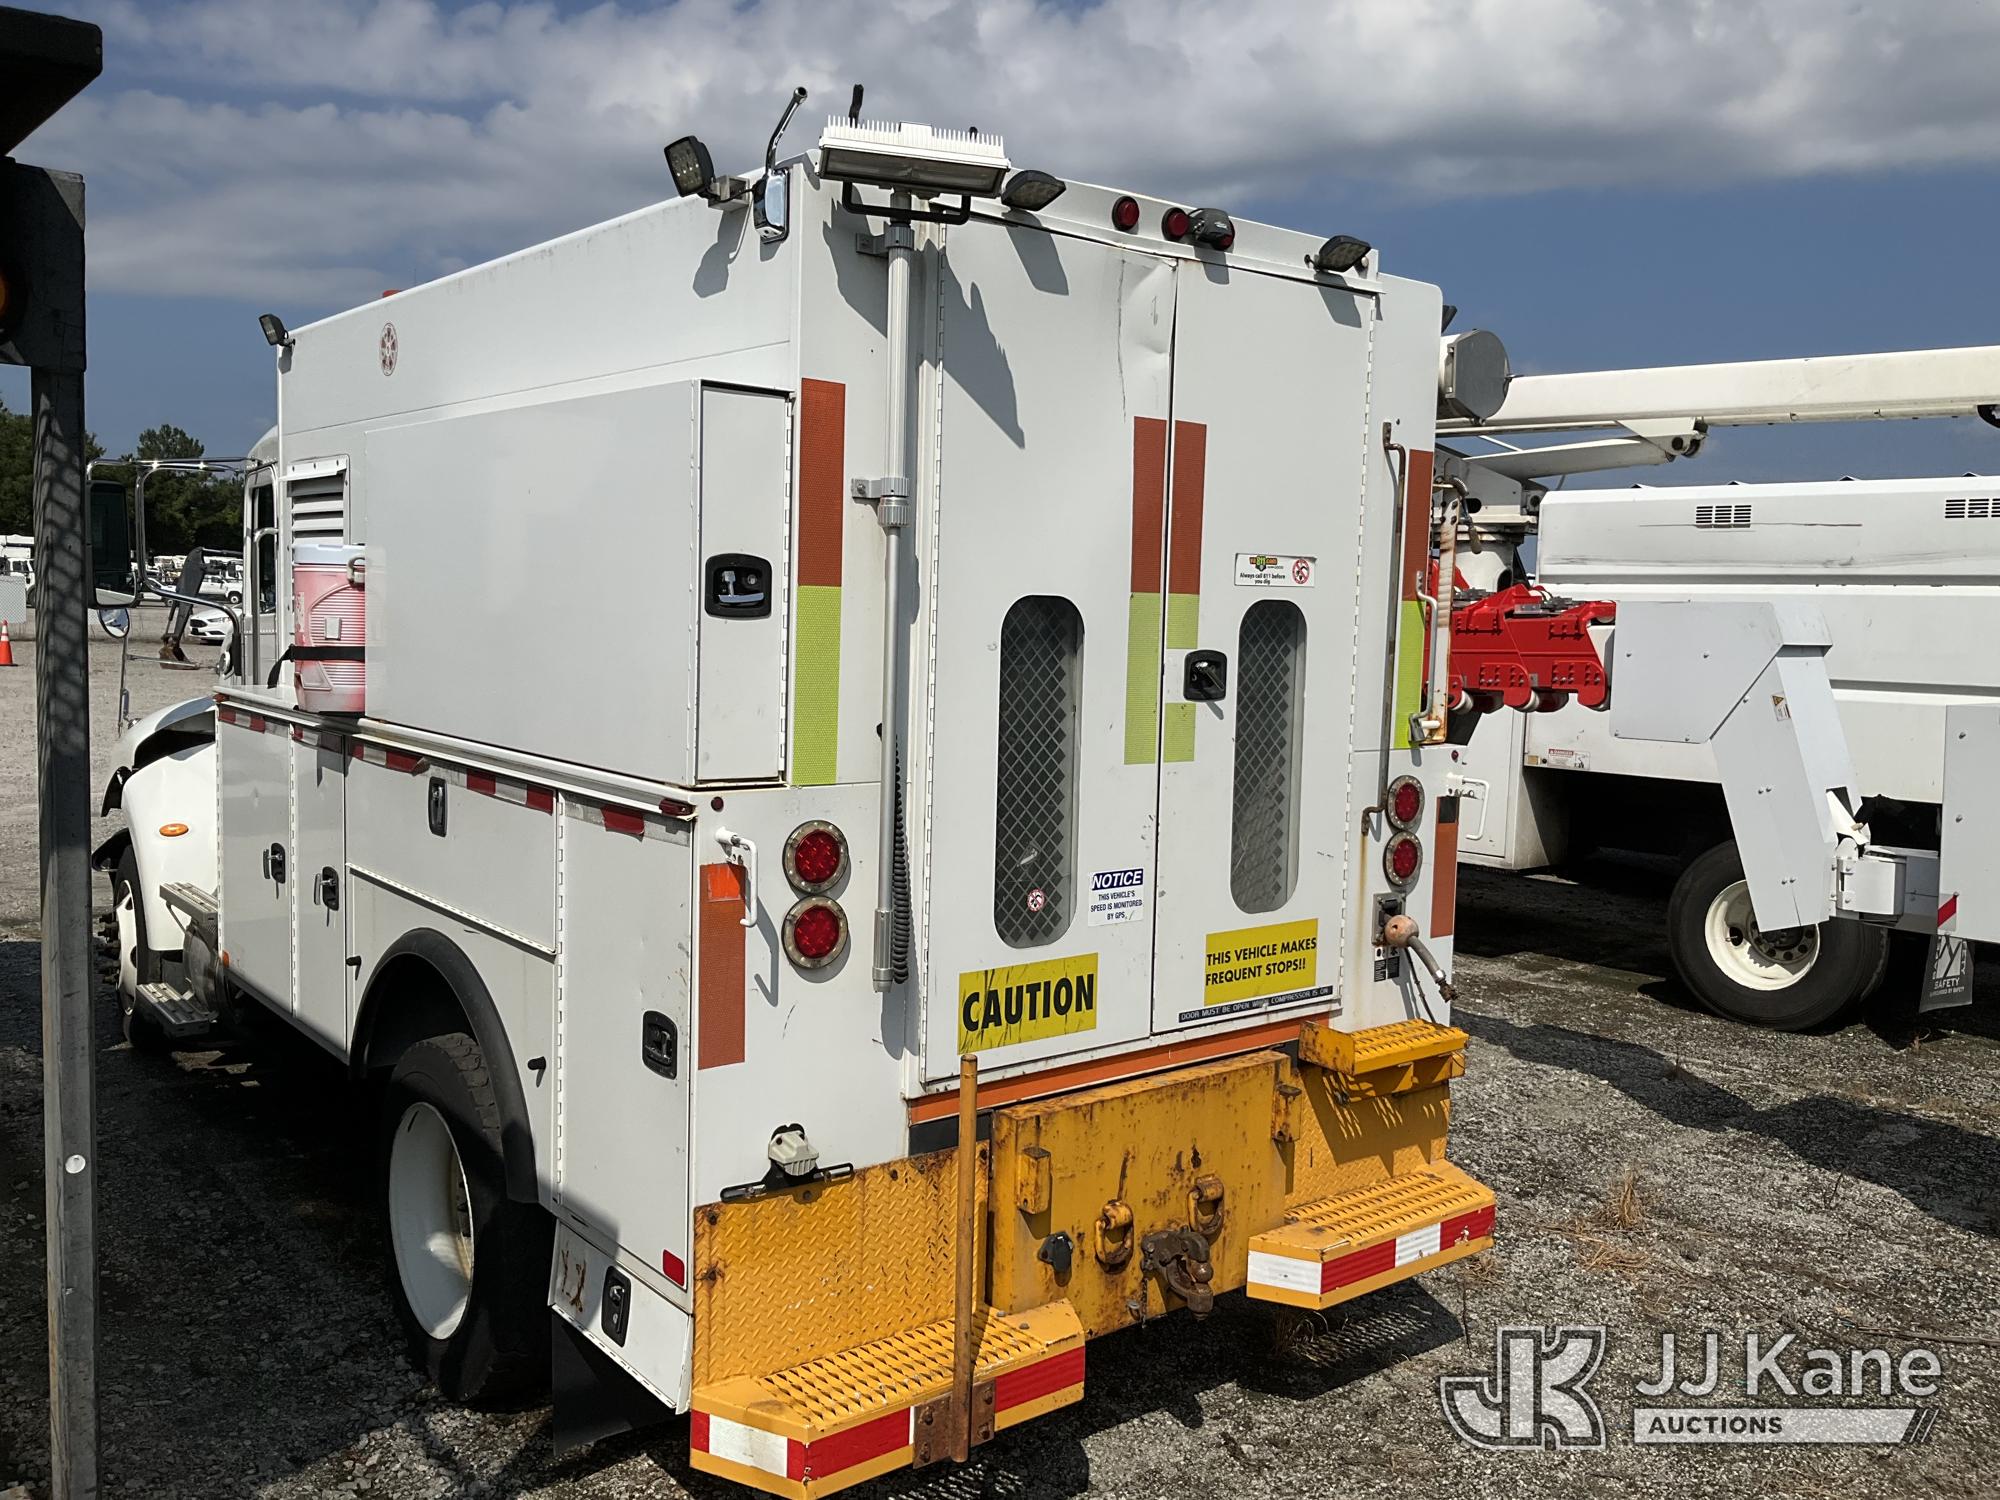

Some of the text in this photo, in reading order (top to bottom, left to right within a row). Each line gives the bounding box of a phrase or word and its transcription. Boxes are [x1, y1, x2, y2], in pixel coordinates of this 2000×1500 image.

[1092, 870, 1142, 889] NOTICE
[1090, 899, 1143, 912] SPEED IS MONITORED
[1098, 890, 1135, 901] THIS VEHICLE'S
[1206, 937, 1317, 966] THIS VEHICLE MAKES
[1205, 958, 1306, 986] FREQUENT STOPS!!
[1934, 978, 1960, 989] SAFETY
[962, 974, 1094, 1032] CAUTION
[1181, 1009, 1199, 1020] DOOR
[1202, 1007, 1219, 1017] MUST
[1222, 1004, 1231, 1013] BE
[1233, 1001, 1249, 1011] OPEN
[1271, 990, 1311, 1004] COMPRESSOR
[1312, 988, 1318, 996] IS
